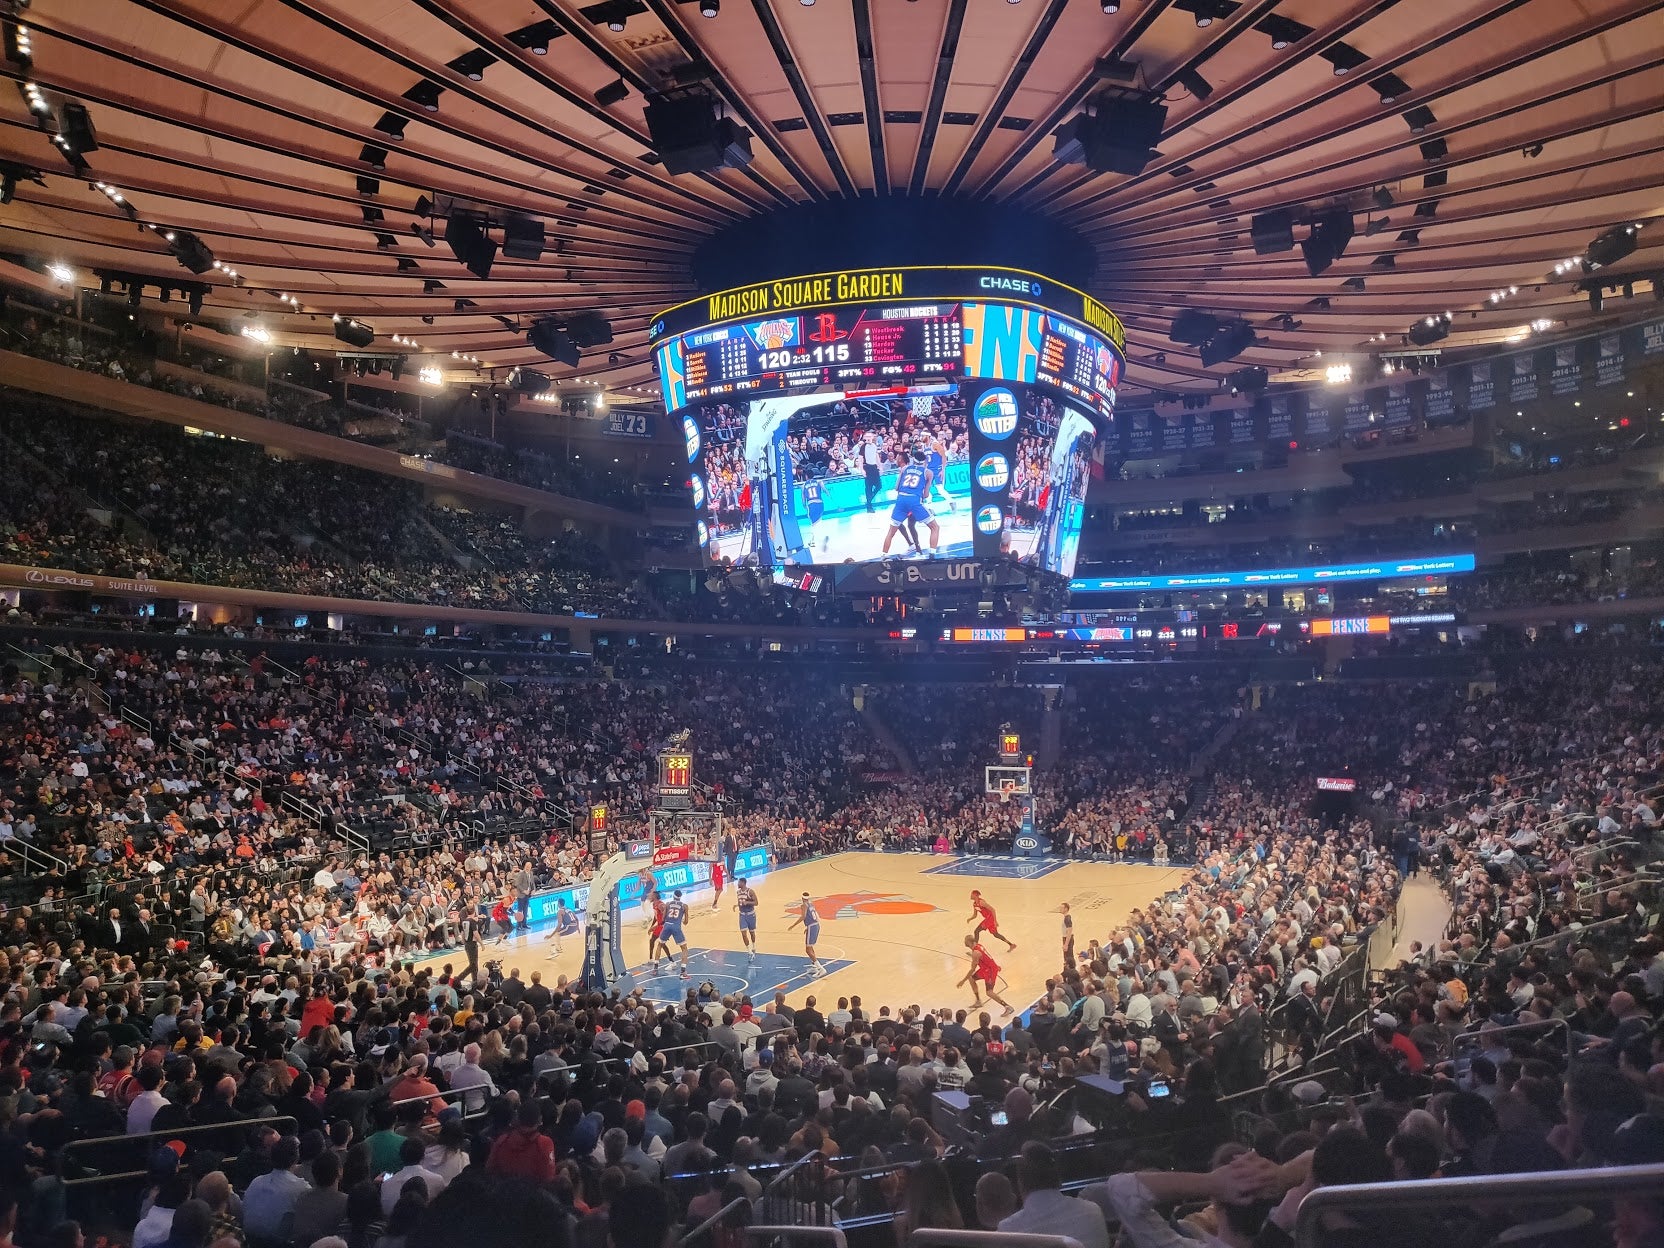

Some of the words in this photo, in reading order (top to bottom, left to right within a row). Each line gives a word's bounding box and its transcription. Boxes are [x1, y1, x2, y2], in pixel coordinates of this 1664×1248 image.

[980, 276, 1030, 292] CHASE
[709, 287, 768, 320] MADISON
[773, 279, 831, 307] SQUARE
[837, 273, 903, 299] GARDEN
[883, 308, 909, 319] HOUSTON
[910, 306, 938, 317] ROCKETS
[758, 351, 791, 369] 120
[793, 354, 810, 364] 2:32
[813, 344, 849, 362] 115
[1597, 355, 1624, 368] 2014-15
[838, 369, 861, 377] 3PT%
[863, 367, 875, 375] 36
[883, 366, 902, 374] FG%
[904, 365, 915, 373] 42
[1552, 366, 1580, 377] 2014-15
[1469, 382, 1494, 392] 2011-12
[609, 413, 625, 424] BILLY
[626, 415, 646, 433] 73
[610, 422, 624, 431] JOEL
[400, 457, 425, 471] CHASE
[780, 456, 789, 515] SQUARESPACE
[903, 474, 920, 488] 23
[808, 486, 817, 498] 11
[45, 574, 94, 587] LEXUS
[108, 581, 132, 592] SUITE
[134, 583, 158, 593] LEVEL
[669, 758, 688, 768] 2:32
[671, 770, 686, 785] 11
[594, 808, 605, 818] 2:32
[1018, 839, 1035, 847] KIA
[664, 868, 687, 887] SELTZER
[668, 908, 680, 918] 23
